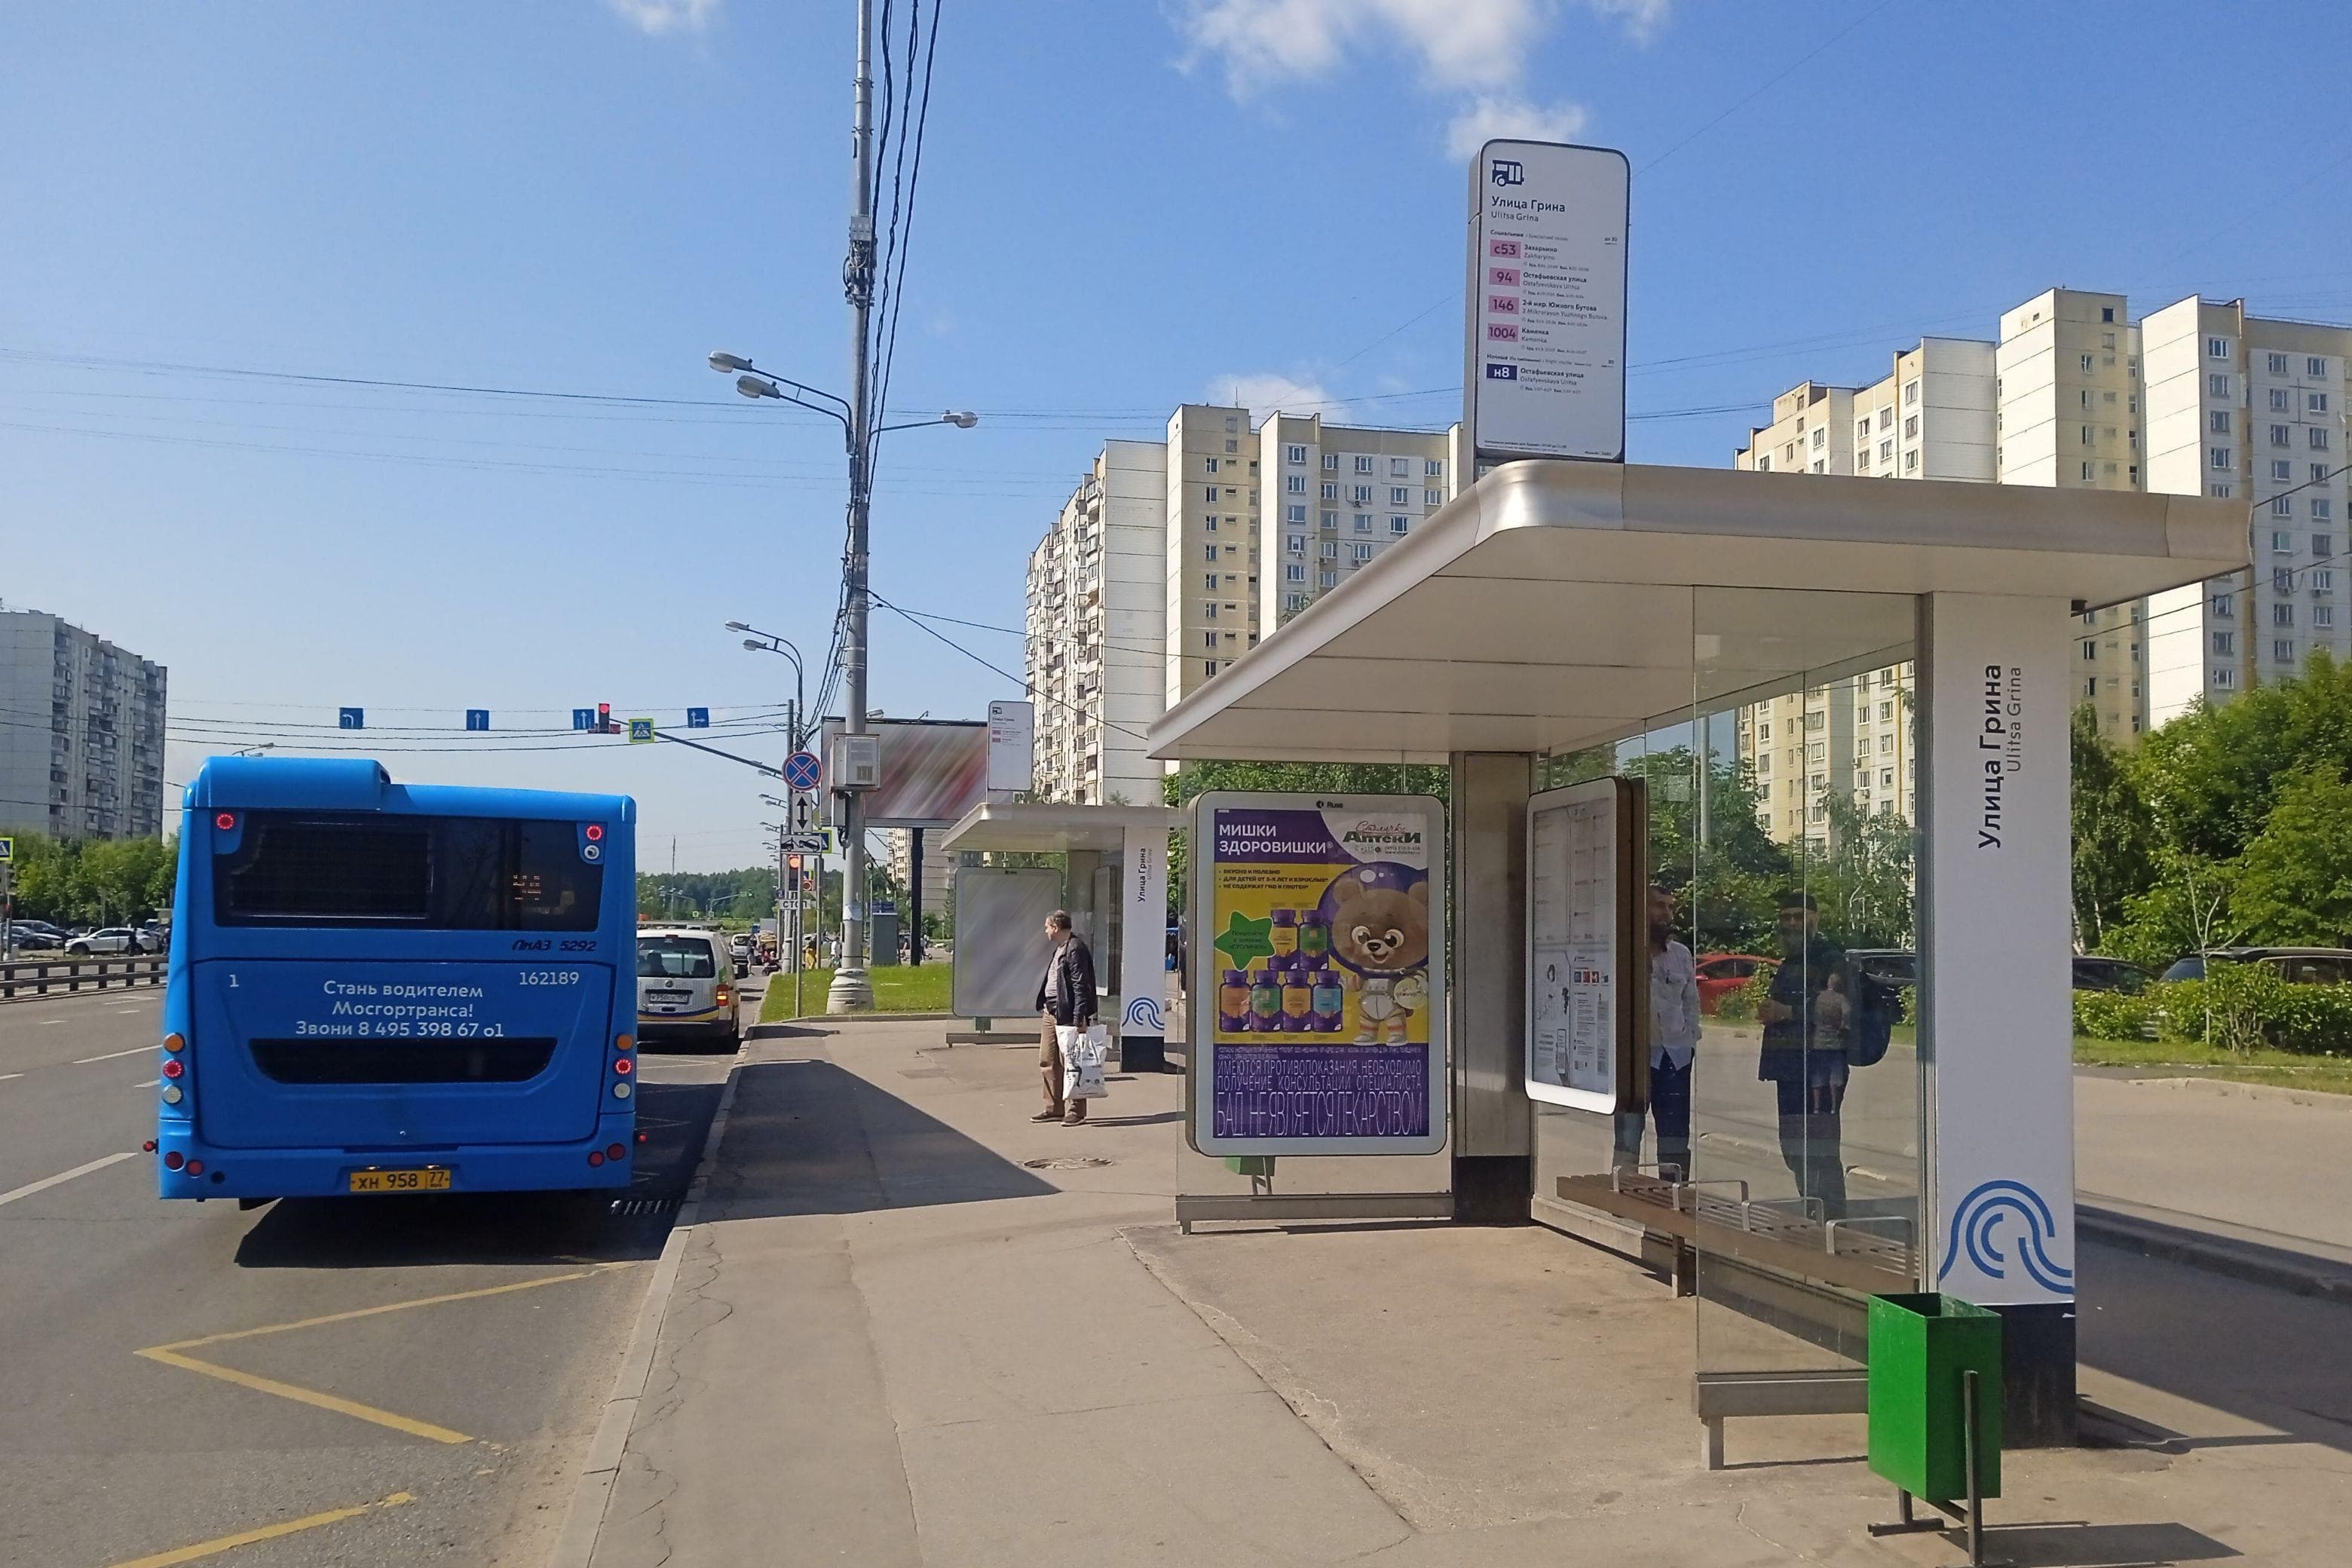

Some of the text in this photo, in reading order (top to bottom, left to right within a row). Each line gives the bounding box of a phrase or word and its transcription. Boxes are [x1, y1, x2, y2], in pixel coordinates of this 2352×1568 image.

[1491, 196, 1566, 213] Улица Грина
[1491, 211, 1539, 222] Ulitsa Grina
[1496, 271, 1512, 283] 94
[1493, 299, 1514, 311] 146
[1548, 302, 1574, 310] Южного
[1489, 326, 1516, 338] 1004
[1493, 367, 1509, 378] н8
[2006, 667, 2021, 772] Ulitsa Grina
[1978, 665, 2006, 849] Улица Грина
[1219, 824, 1276, 837] МИШКИ
[1138, 848, 1147, 902] Улица Грина
[559, 940, 598, 951] 5292
[229, 974, 240, 988] 1
[519, 972, 580, 985] 162189
[323, 980, 483, 998] Стань водителем
[332, 1001, 473, 1019] Мосгортранса!
[296, 1021, 353, 1036] Звони
[358, 1022, 369, 1036] 8
[375, 1022, 410, 1036] 495
[417, 1022, 452, 1036] 398
[457, 1023, 479, 1037] 67
[1217, 1060, 1261, 1075] ИМЕЮТСЯ
[1361, 1060, 1422, 1075] НЕОБХОДИМО
[1217, 1075, 1422, 1091] ПОЛУЧЕНИЕ КОНСУЛЬТАЦИИ СПЕЦИАЛИСТА
[1250, 1092, 1266, 1135] НЕ
[1269, 1092, 1334, 1135] ЯВЛЯЕТСЯ
[1336, 1091, 1422, 1135] ЛЕКАРСТВОМ
[386, 1173, 418, 1188] 958
[428, 1171, 445, 1184] 77
